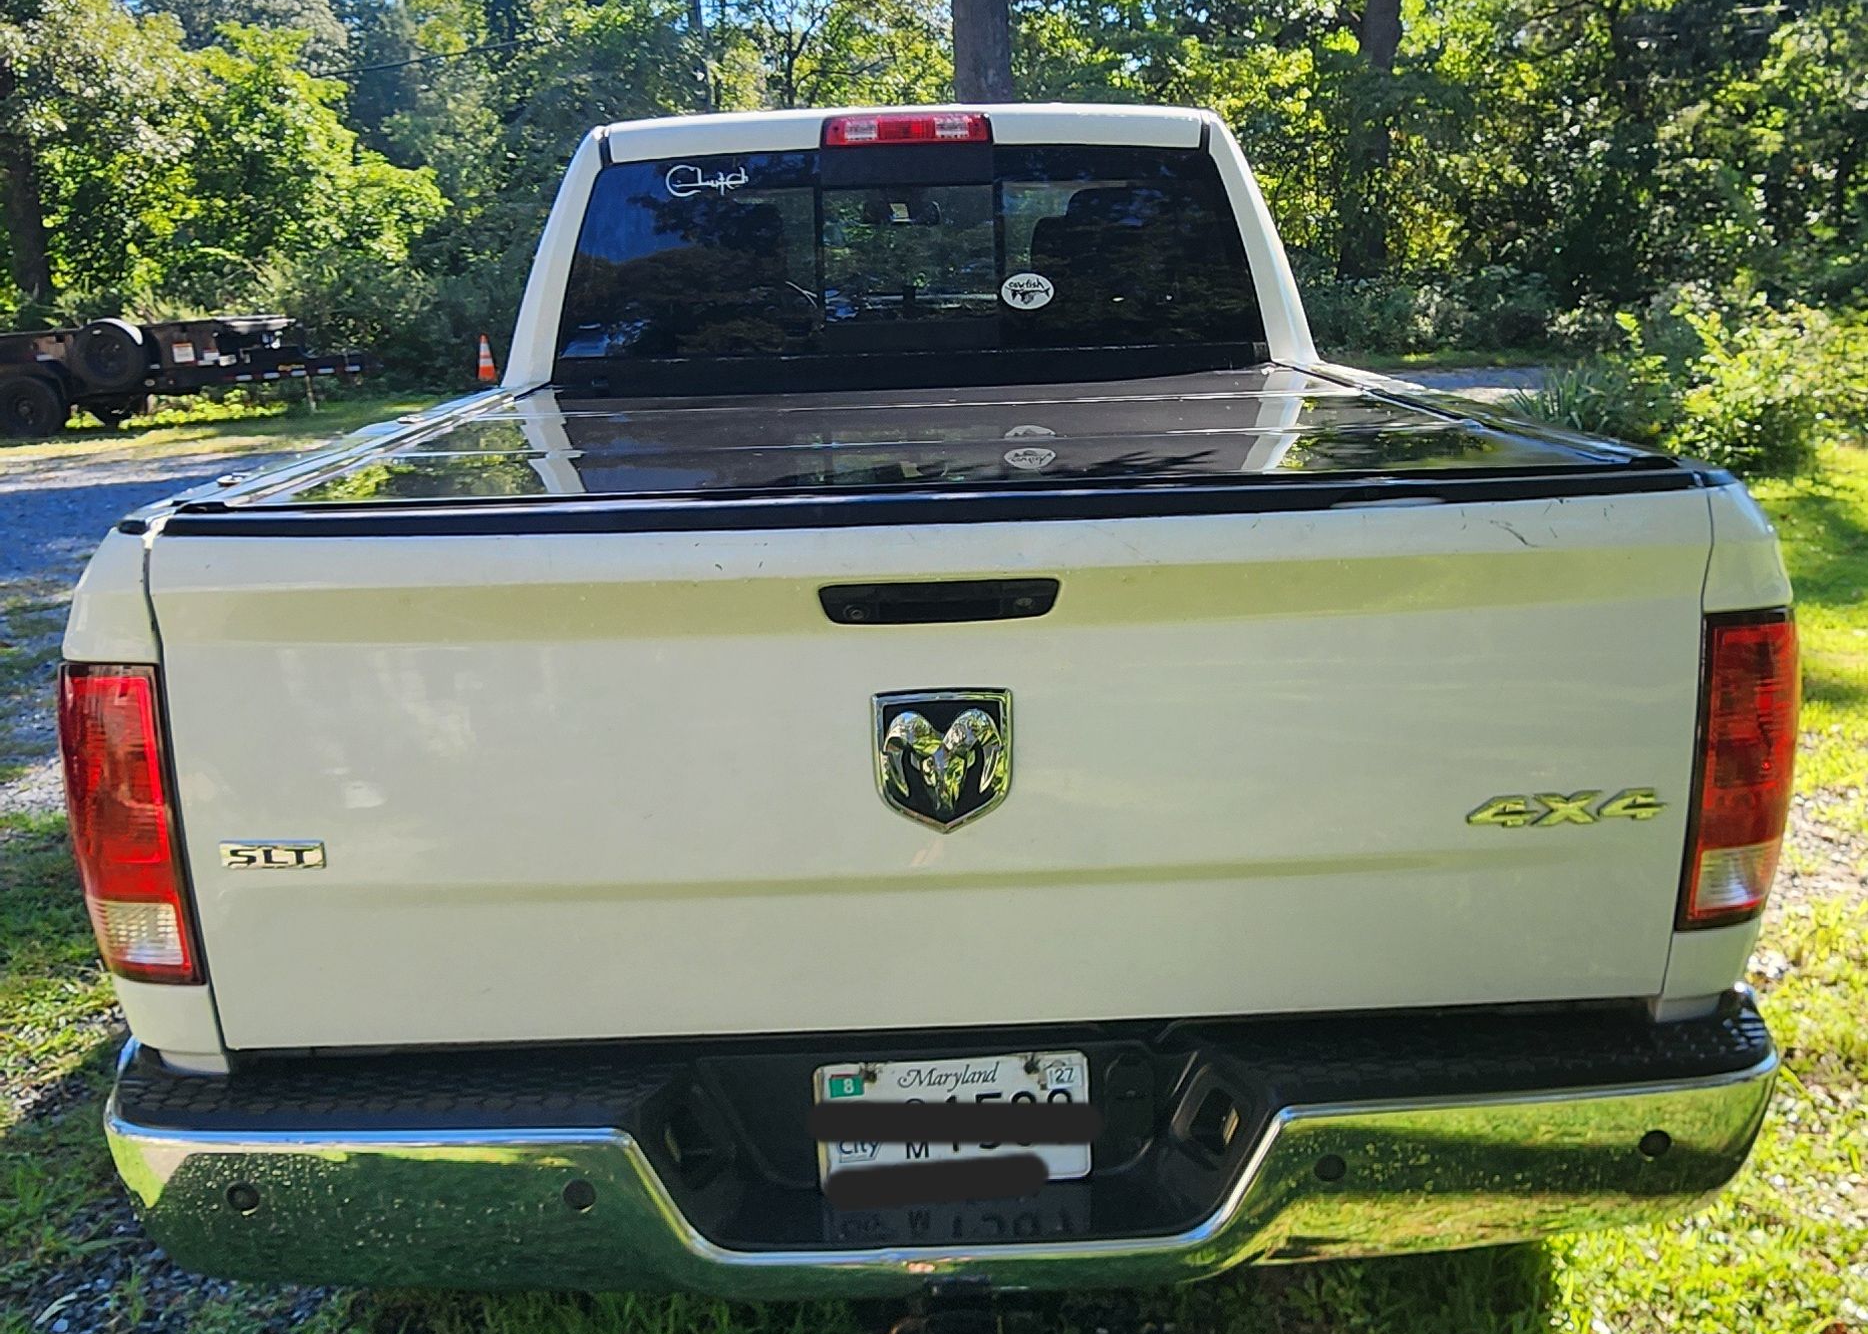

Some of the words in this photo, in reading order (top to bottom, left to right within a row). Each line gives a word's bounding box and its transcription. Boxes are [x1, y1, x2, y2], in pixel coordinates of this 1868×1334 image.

[227, 848, 316, 866] SLT
[898, 1061, 1000, 1092] Maryland
[1055, 1067, 1075, 1084] 27
[843, 1078, 855, 1094] 8
